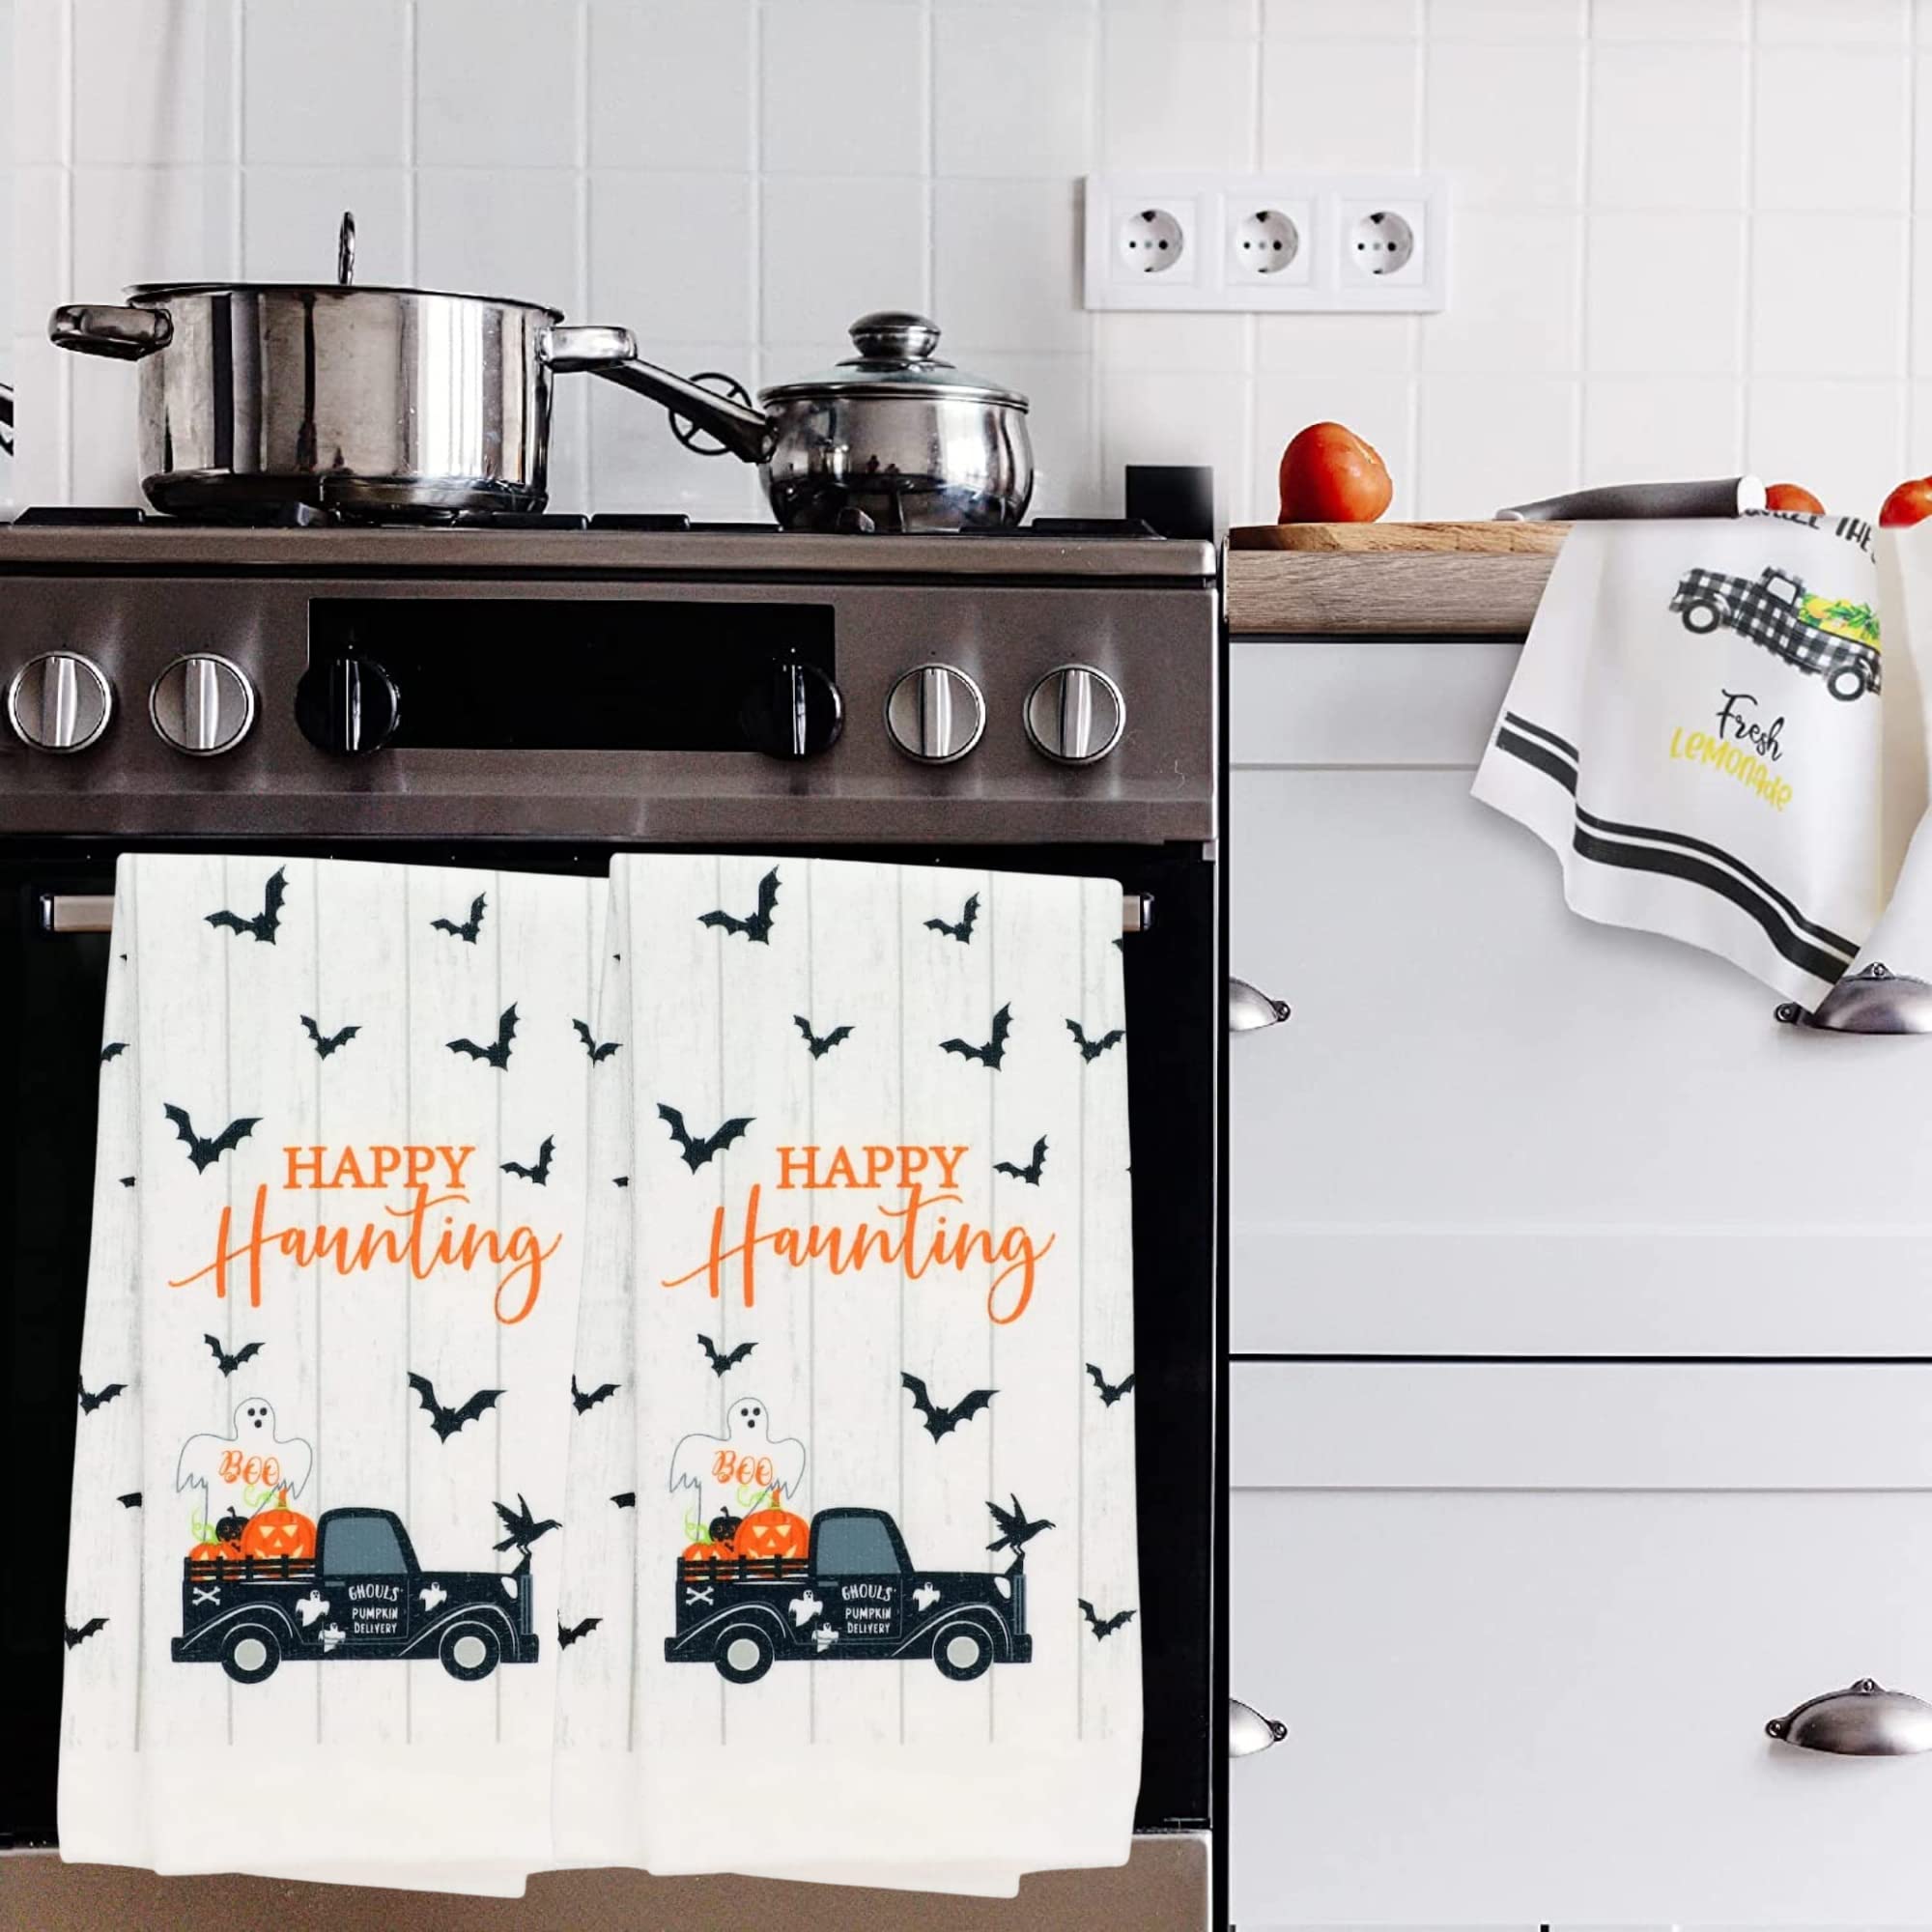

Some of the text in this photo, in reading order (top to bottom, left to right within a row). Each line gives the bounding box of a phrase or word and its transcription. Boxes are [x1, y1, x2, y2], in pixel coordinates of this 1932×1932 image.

[1716, 688, 1785, 762] Fresh
[283, 1145, 476, 1189] HAPPY
[777, 1145, 970, 1189] HAPPY
[168, 1183, 562, 1325] Haunting
[662, 1183, 1056, 1325] Haunting
[218, 1450, 280, 1487] BOO
[712, 1450, 774, 1487] BOO
[352, 1606, 399, 1620] PUMPKIN
[354, 1621, 398, 1634] DELIVERY
[845, 1606, 893, 1620] PUMPKIN
[847, 1621, 892, 1634] DELIVERY
